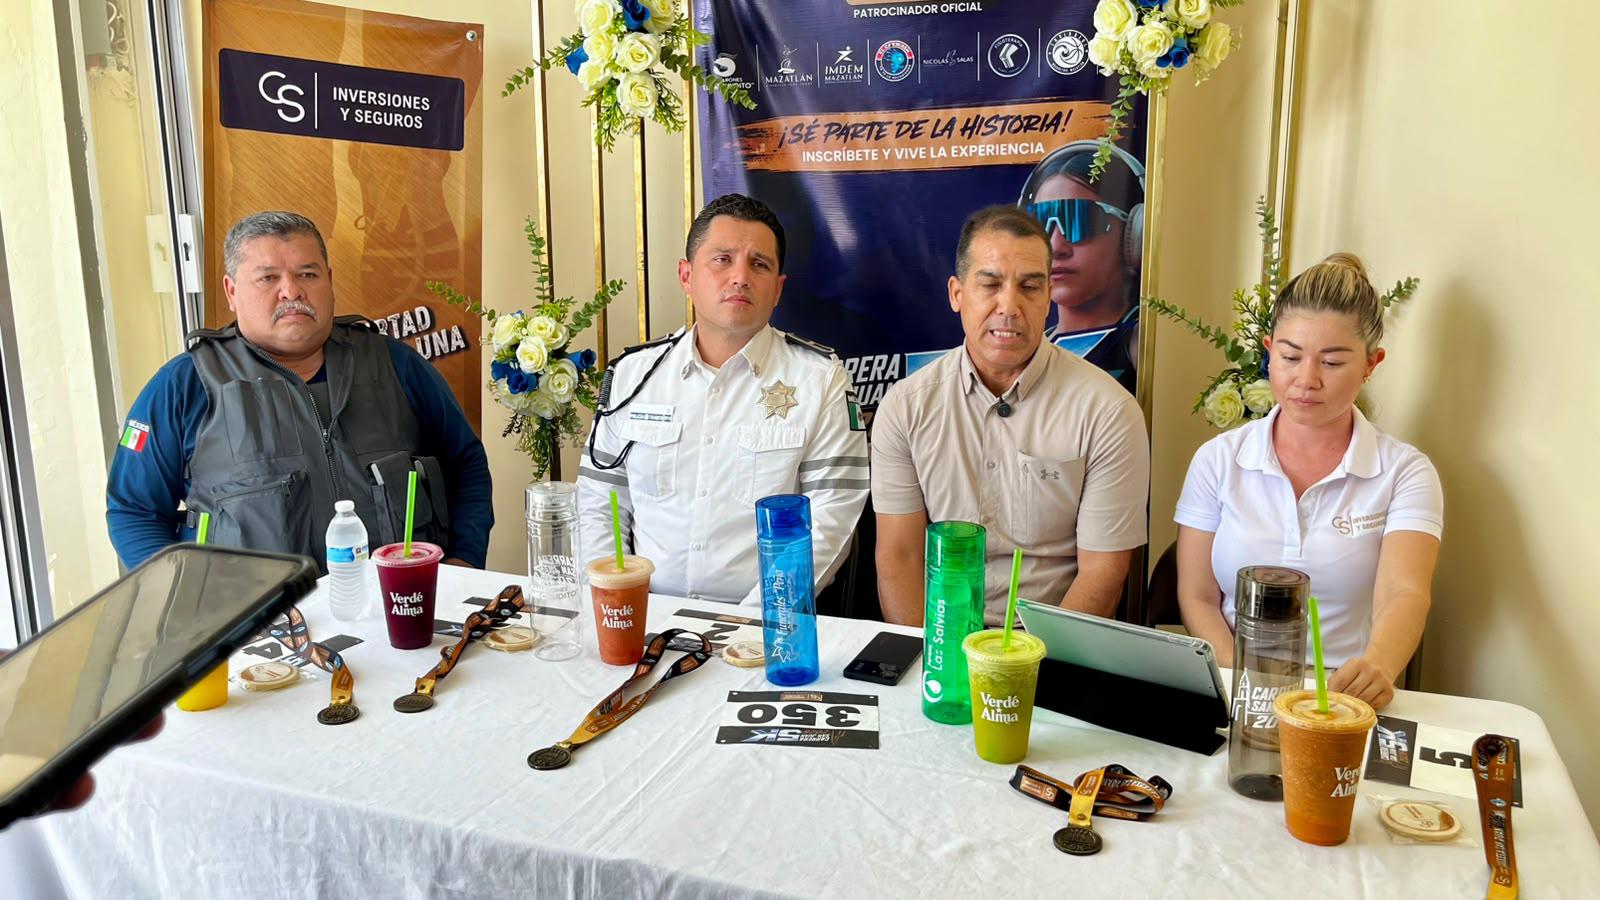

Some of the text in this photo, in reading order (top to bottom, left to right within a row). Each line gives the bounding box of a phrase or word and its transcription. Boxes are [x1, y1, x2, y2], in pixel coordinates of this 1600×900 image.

[853, 2, 982, 18] PATROCINADOR OFICIAL
[825, 64, 863, 75] IMDEM
[258, 71, 305, 123] CS
[333, 86, 430, 111] INVERSIONES
[340, 107, 423, 129] Y SEGUROS
[823, 119, 890, 144] PARTE
[895, 118, 925, 141] DE
[930, 115, 955, 139] LA
[960, 109, 1074, 138] HISTORIA!
[802, 142, 1045, 163] INSCRÍBETE Y VIVE LA EXPERIENCIA
[373, 305, 431, 339] RTAD
[389, 592, 424, 604] Verdé
[391, 604, 424, 617] Alma
[600, 603, 633, 616] Verdé
[602, 617, 634, 630] Alma
[933, 599, 946, 646] Salvias
[980, 691, 1020, 708] Verdé
[736, 703, 861, 728] 350
[981, 708, 1019, 724] Alma
[1419, 746, 1473, 769] 5
